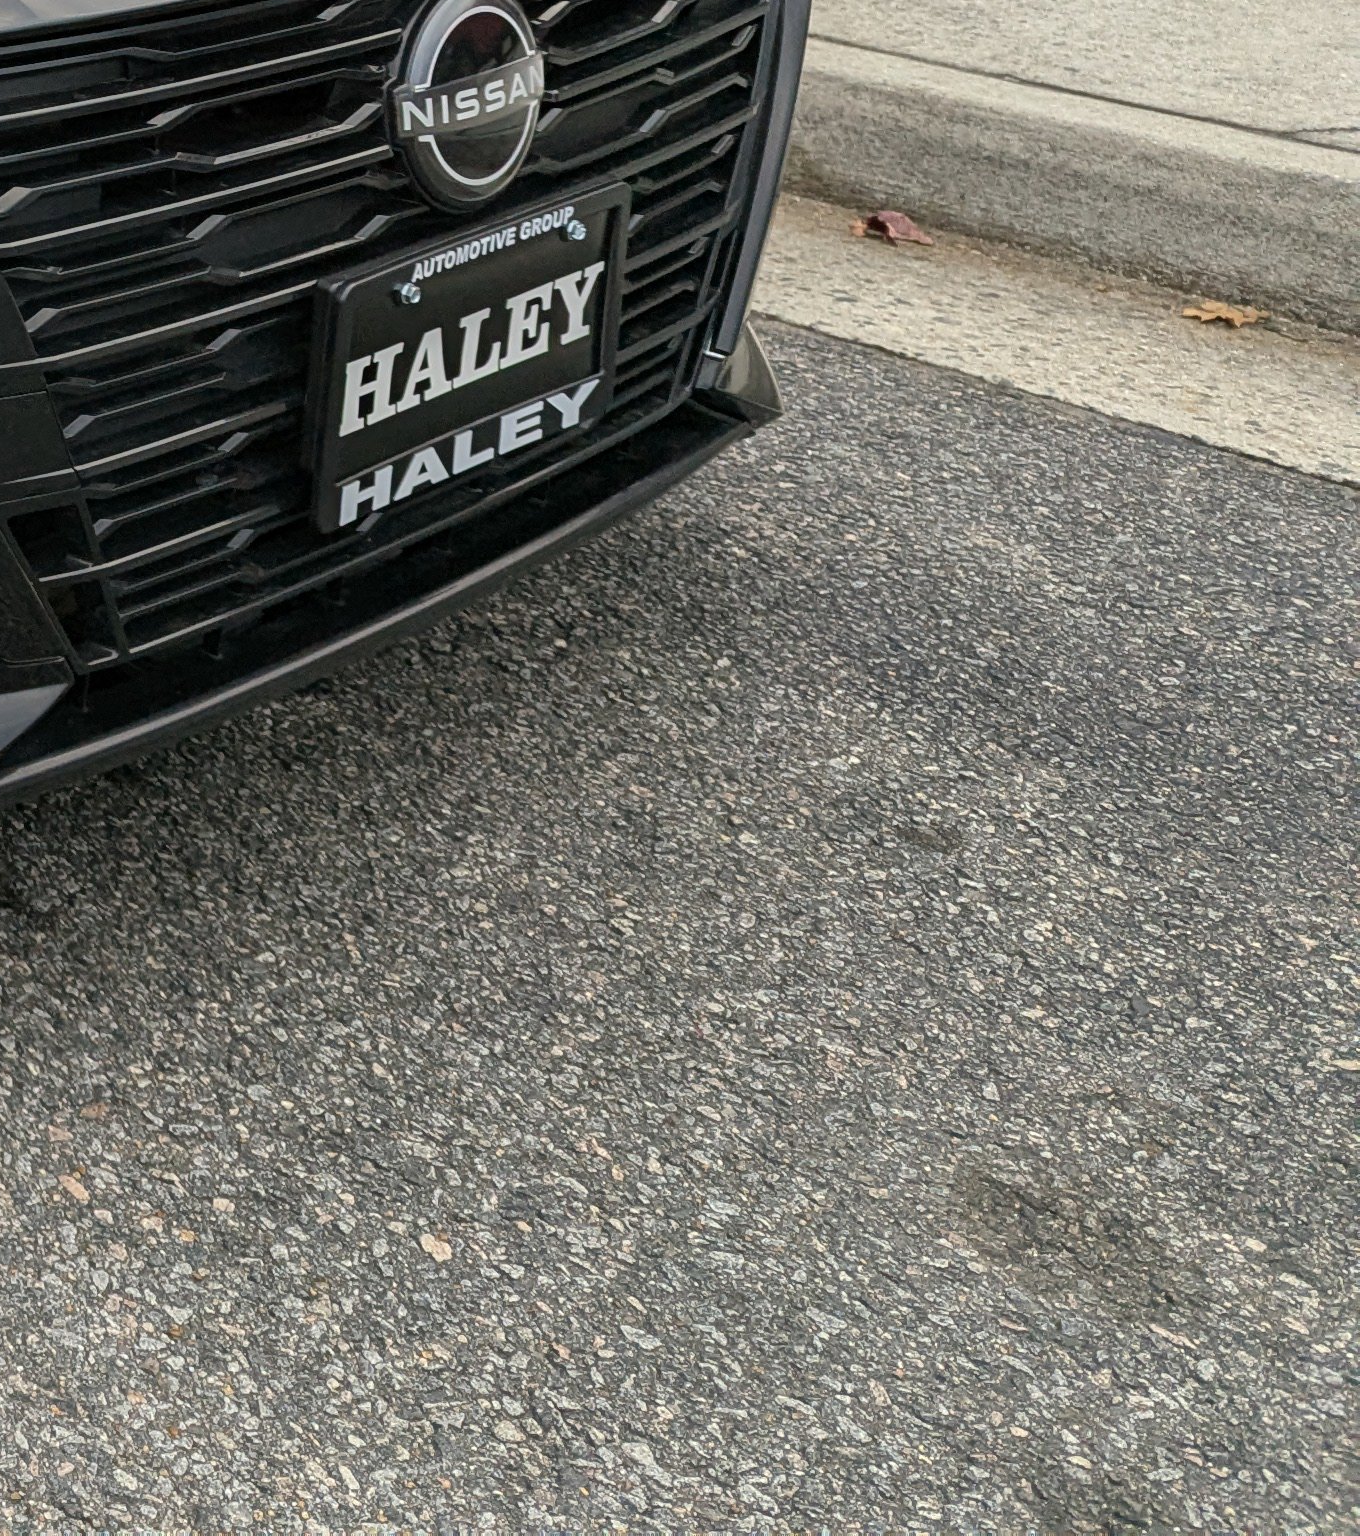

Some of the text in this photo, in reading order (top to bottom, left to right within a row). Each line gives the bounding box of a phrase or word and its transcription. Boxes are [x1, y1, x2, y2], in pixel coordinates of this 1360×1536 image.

[401, 66, 543, 131] NISSAN
[411, 206, 575, 283] AUTOMOTIVE GROUP
[338, 261, 605, 438] HALEY
[338, 379, 602, 526] HALEY
